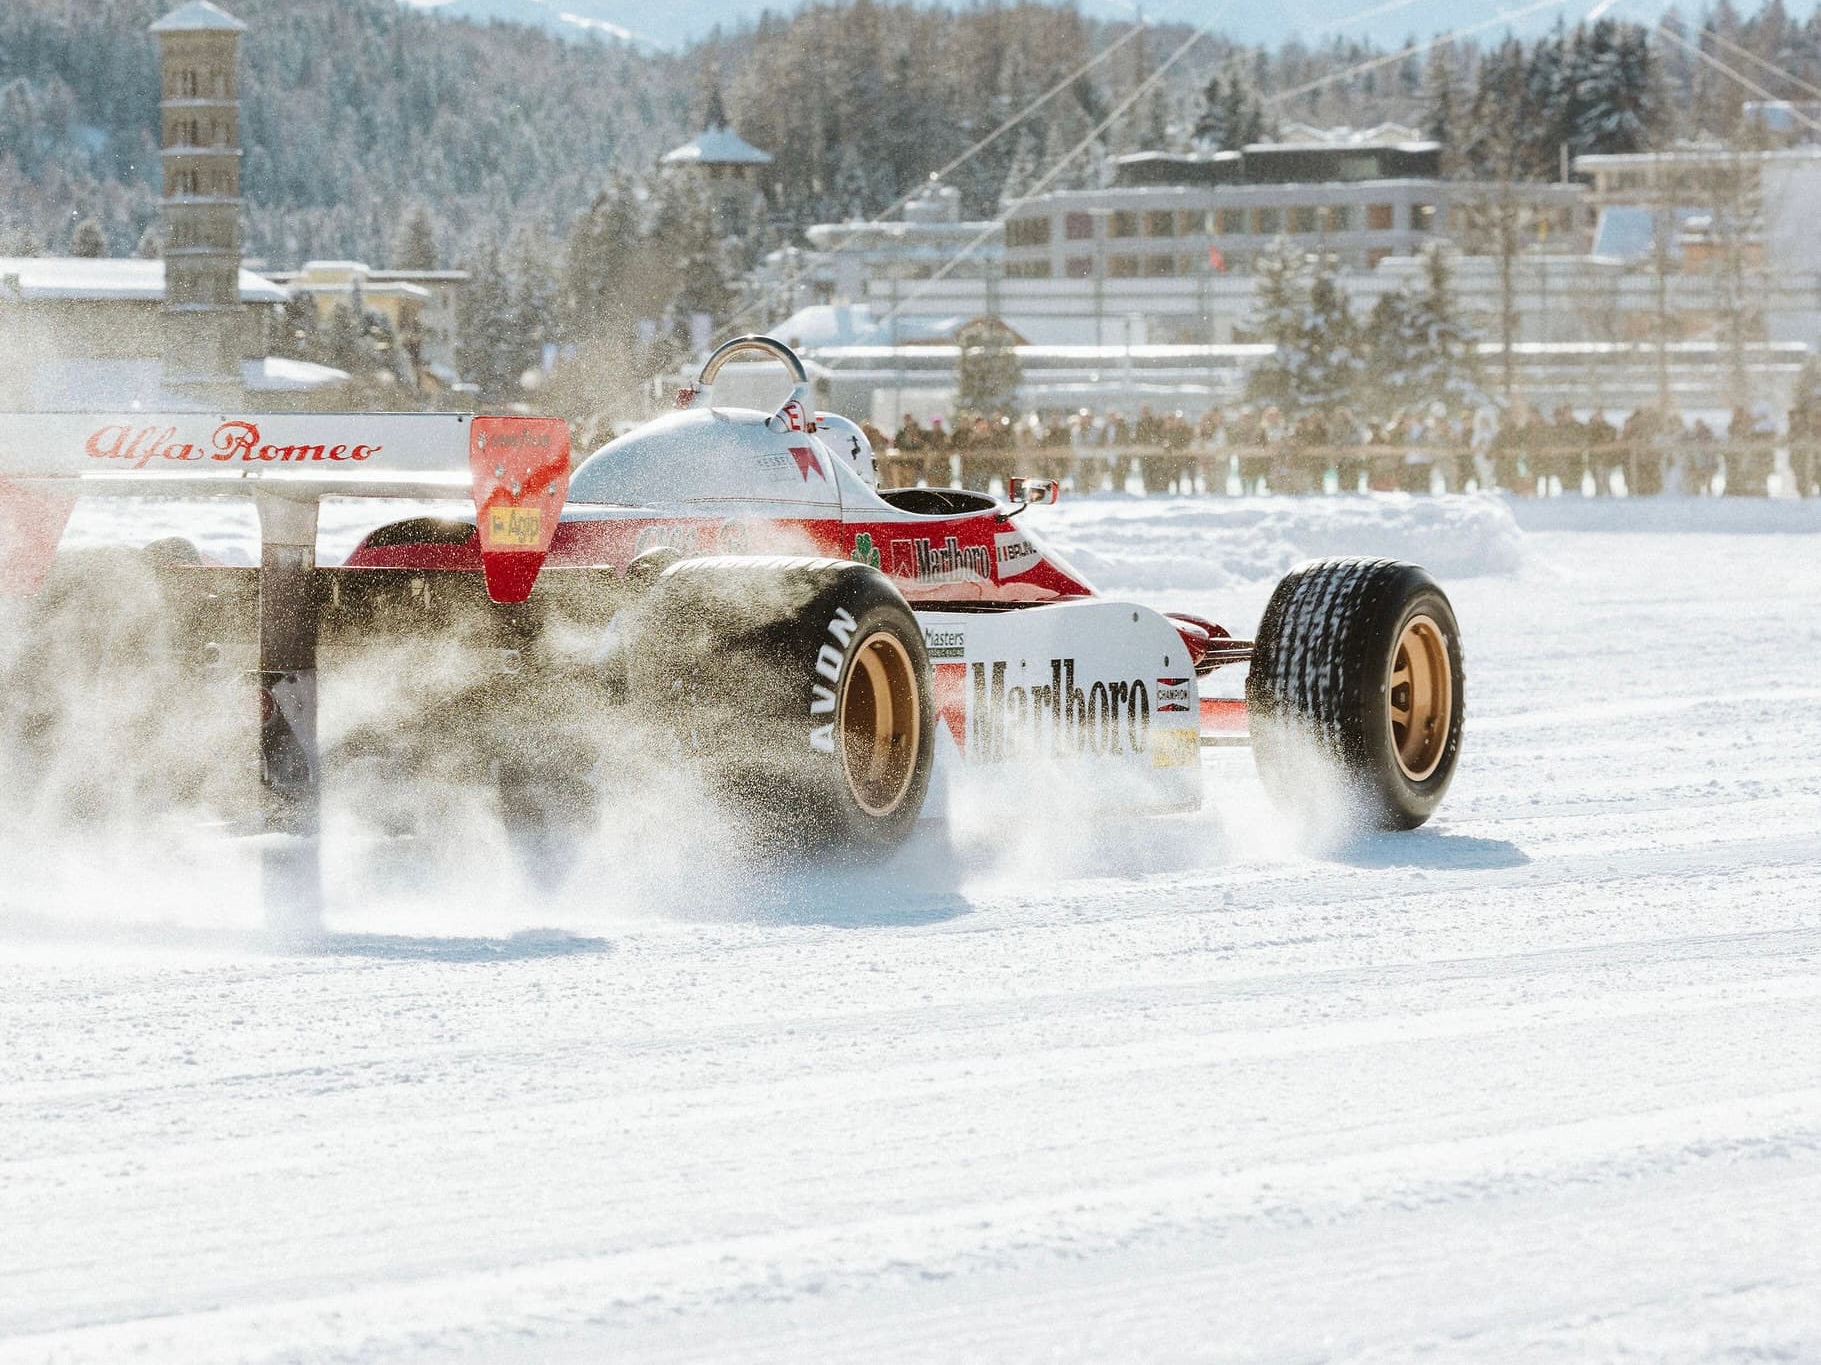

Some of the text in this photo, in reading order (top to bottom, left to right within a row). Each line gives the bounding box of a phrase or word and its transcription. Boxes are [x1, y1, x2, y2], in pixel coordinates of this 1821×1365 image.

[1577, 229, 1718, 295] THE
[1567, 308, 1694, 369] ICE
[84, 420, 383, 469] Alfa Romeo
[914, 537, 990, 582] Marlboro
[924, 627, 965, 647] Masters
[809, 606, 858, 753] AVON
[971, 658, 1150, 763] Marlboro
